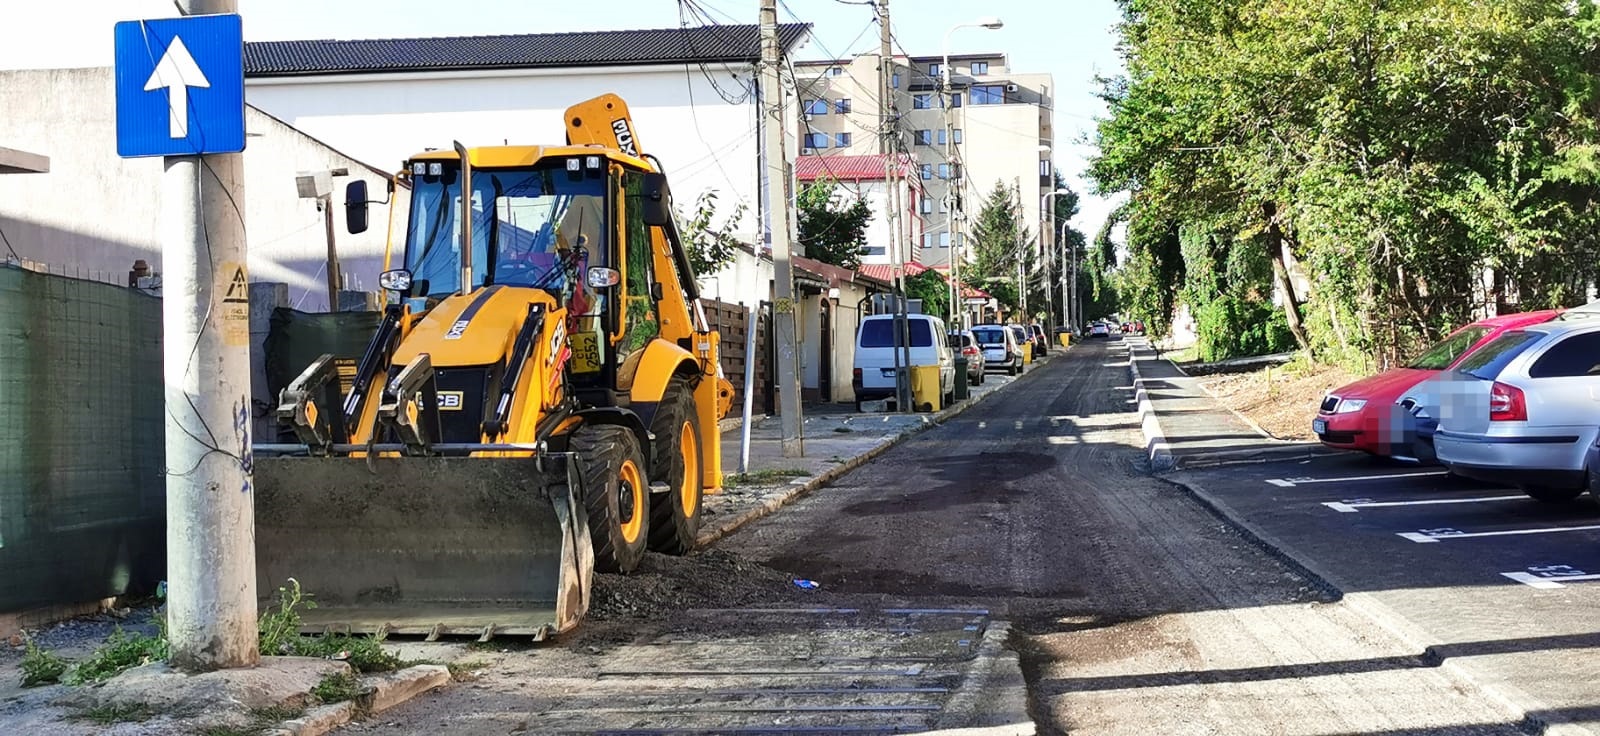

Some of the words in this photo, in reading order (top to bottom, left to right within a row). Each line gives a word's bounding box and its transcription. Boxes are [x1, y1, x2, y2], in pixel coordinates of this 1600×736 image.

[612, 119, 638, 157] 3CX
[549, 318, 565, 365] JCB
[576, 348, 585, 360] CT
[584, 336, 598, 368] 2552
[419, 395, 459, 406] CB
